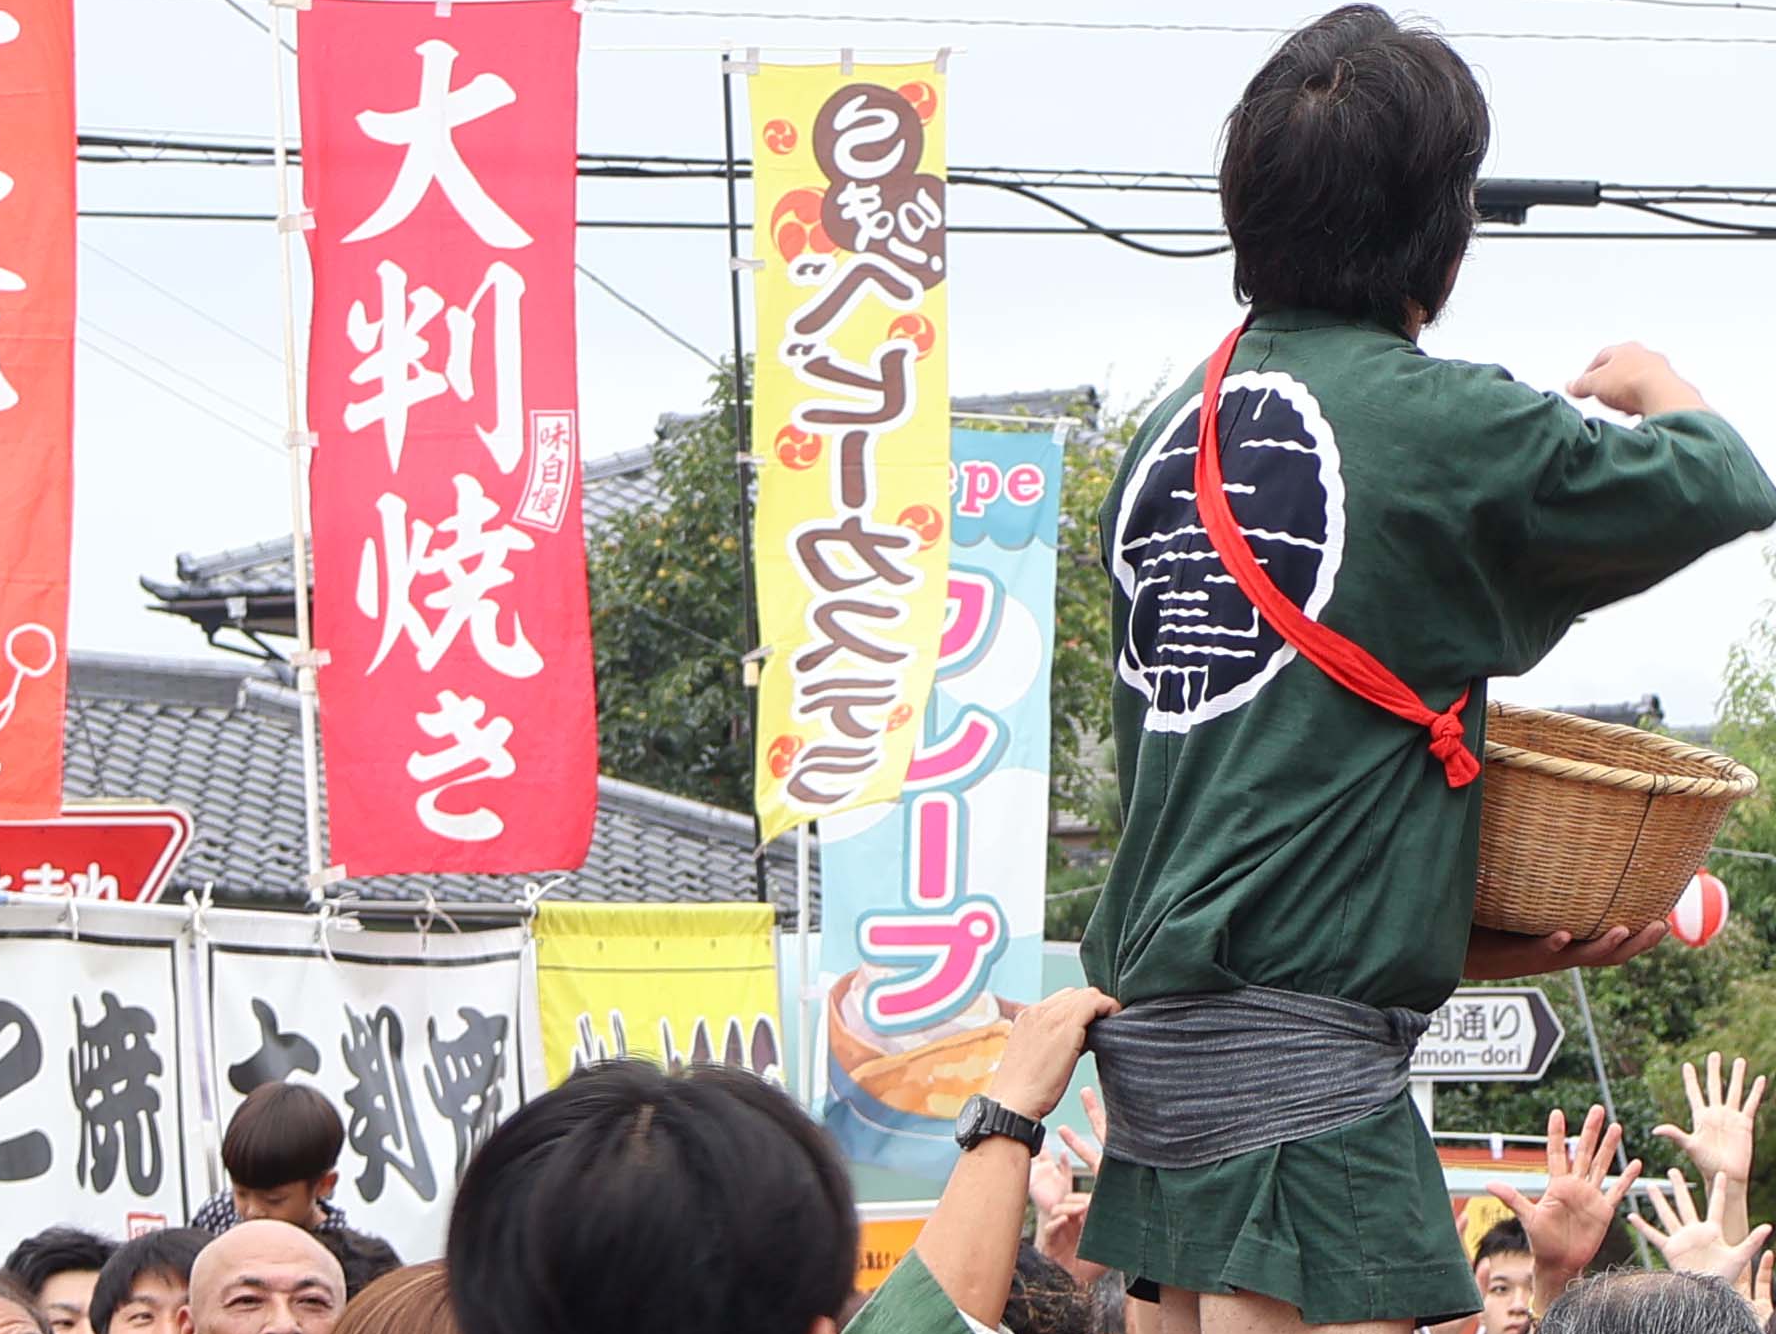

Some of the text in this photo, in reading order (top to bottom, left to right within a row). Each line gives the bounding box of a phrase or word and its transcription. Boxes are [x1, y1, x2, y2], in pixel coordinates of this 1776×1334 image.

[341, 39, 544, 843] 大判焼き
[949, 463, 1041, 513] pe
